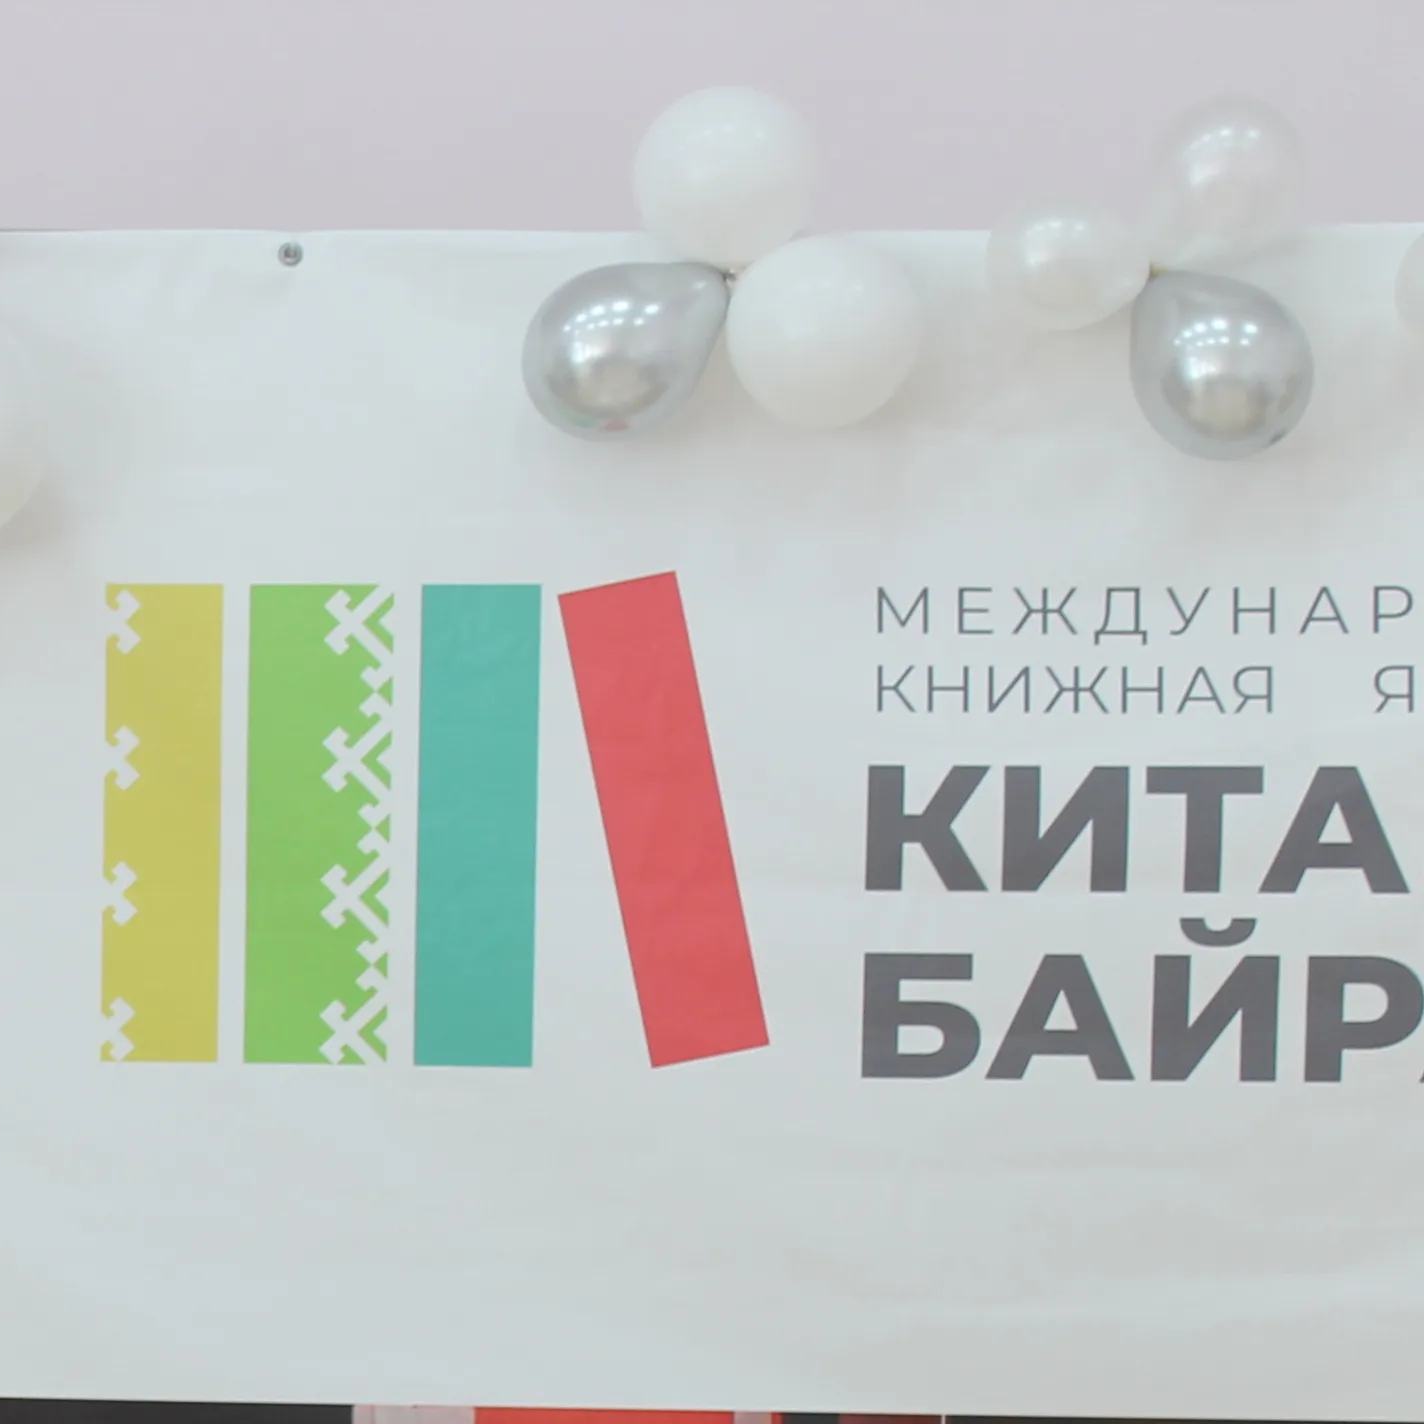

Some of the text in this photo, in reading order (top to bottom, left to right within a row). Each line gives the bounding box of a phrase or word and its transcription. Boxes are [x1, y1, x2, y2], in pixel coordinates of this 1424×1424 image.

[876, 585, 1414, 646] МЕЖДУНАР
[876, 664, 1415, 714] КНИЖНАЯ Я
[864, 764, 1412, 894] КИТА
[861, 917, 1424, 1084] БАЙР
